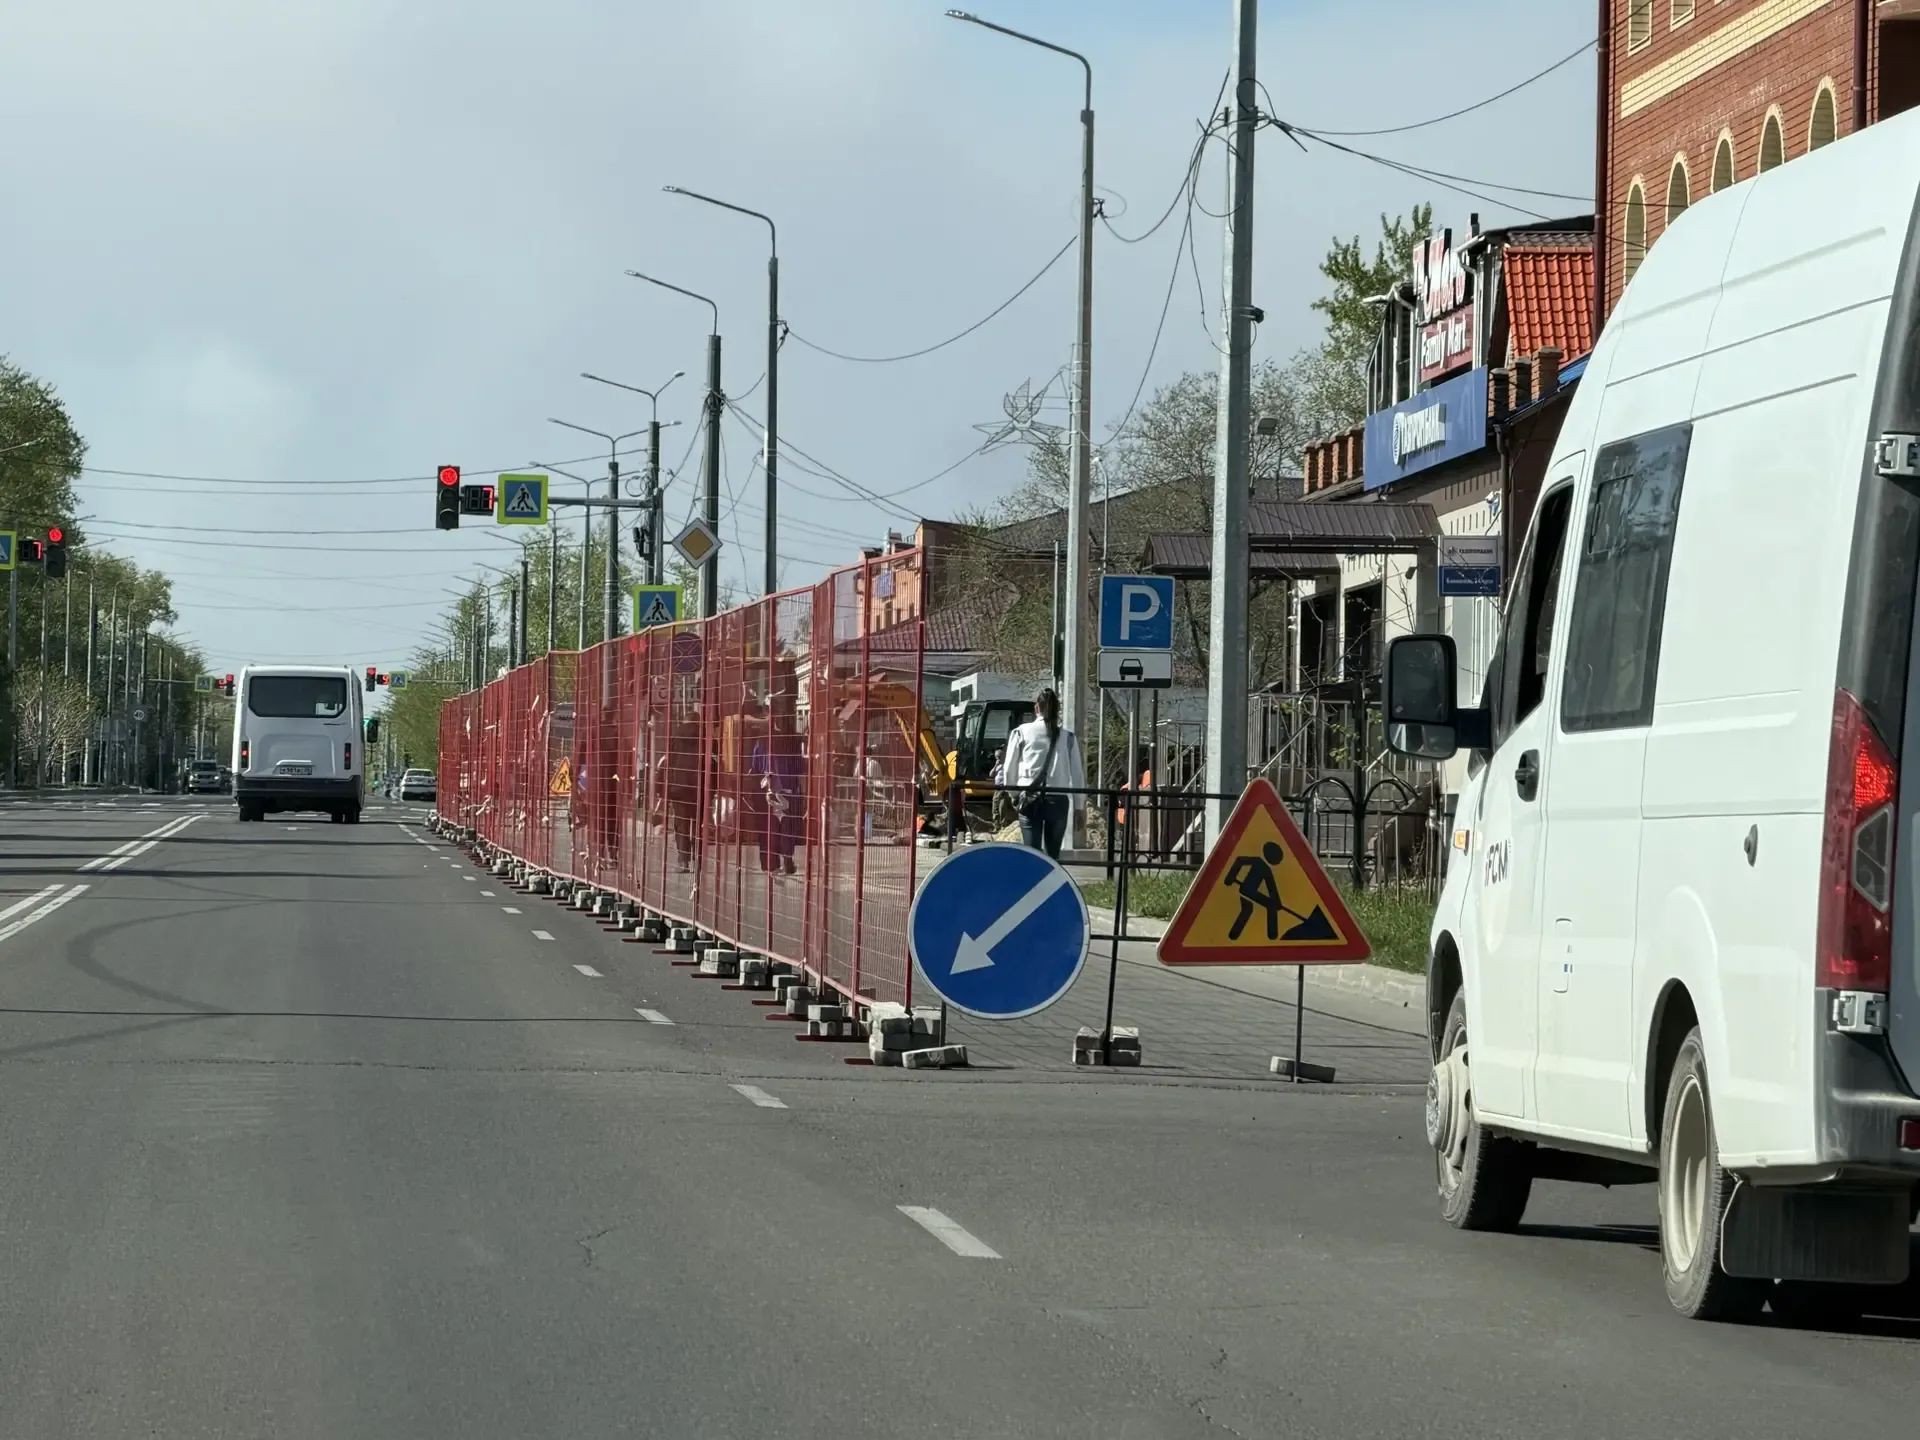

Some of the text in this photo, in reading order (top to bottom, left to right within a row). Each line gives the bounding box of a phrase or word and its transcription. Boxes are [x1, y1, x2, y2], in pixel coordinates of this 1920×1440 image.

[1421, 313, 1466, 369] Family Mart
[482, 487, 494, 510] 7
[1120, 584, 1160, 640] P
